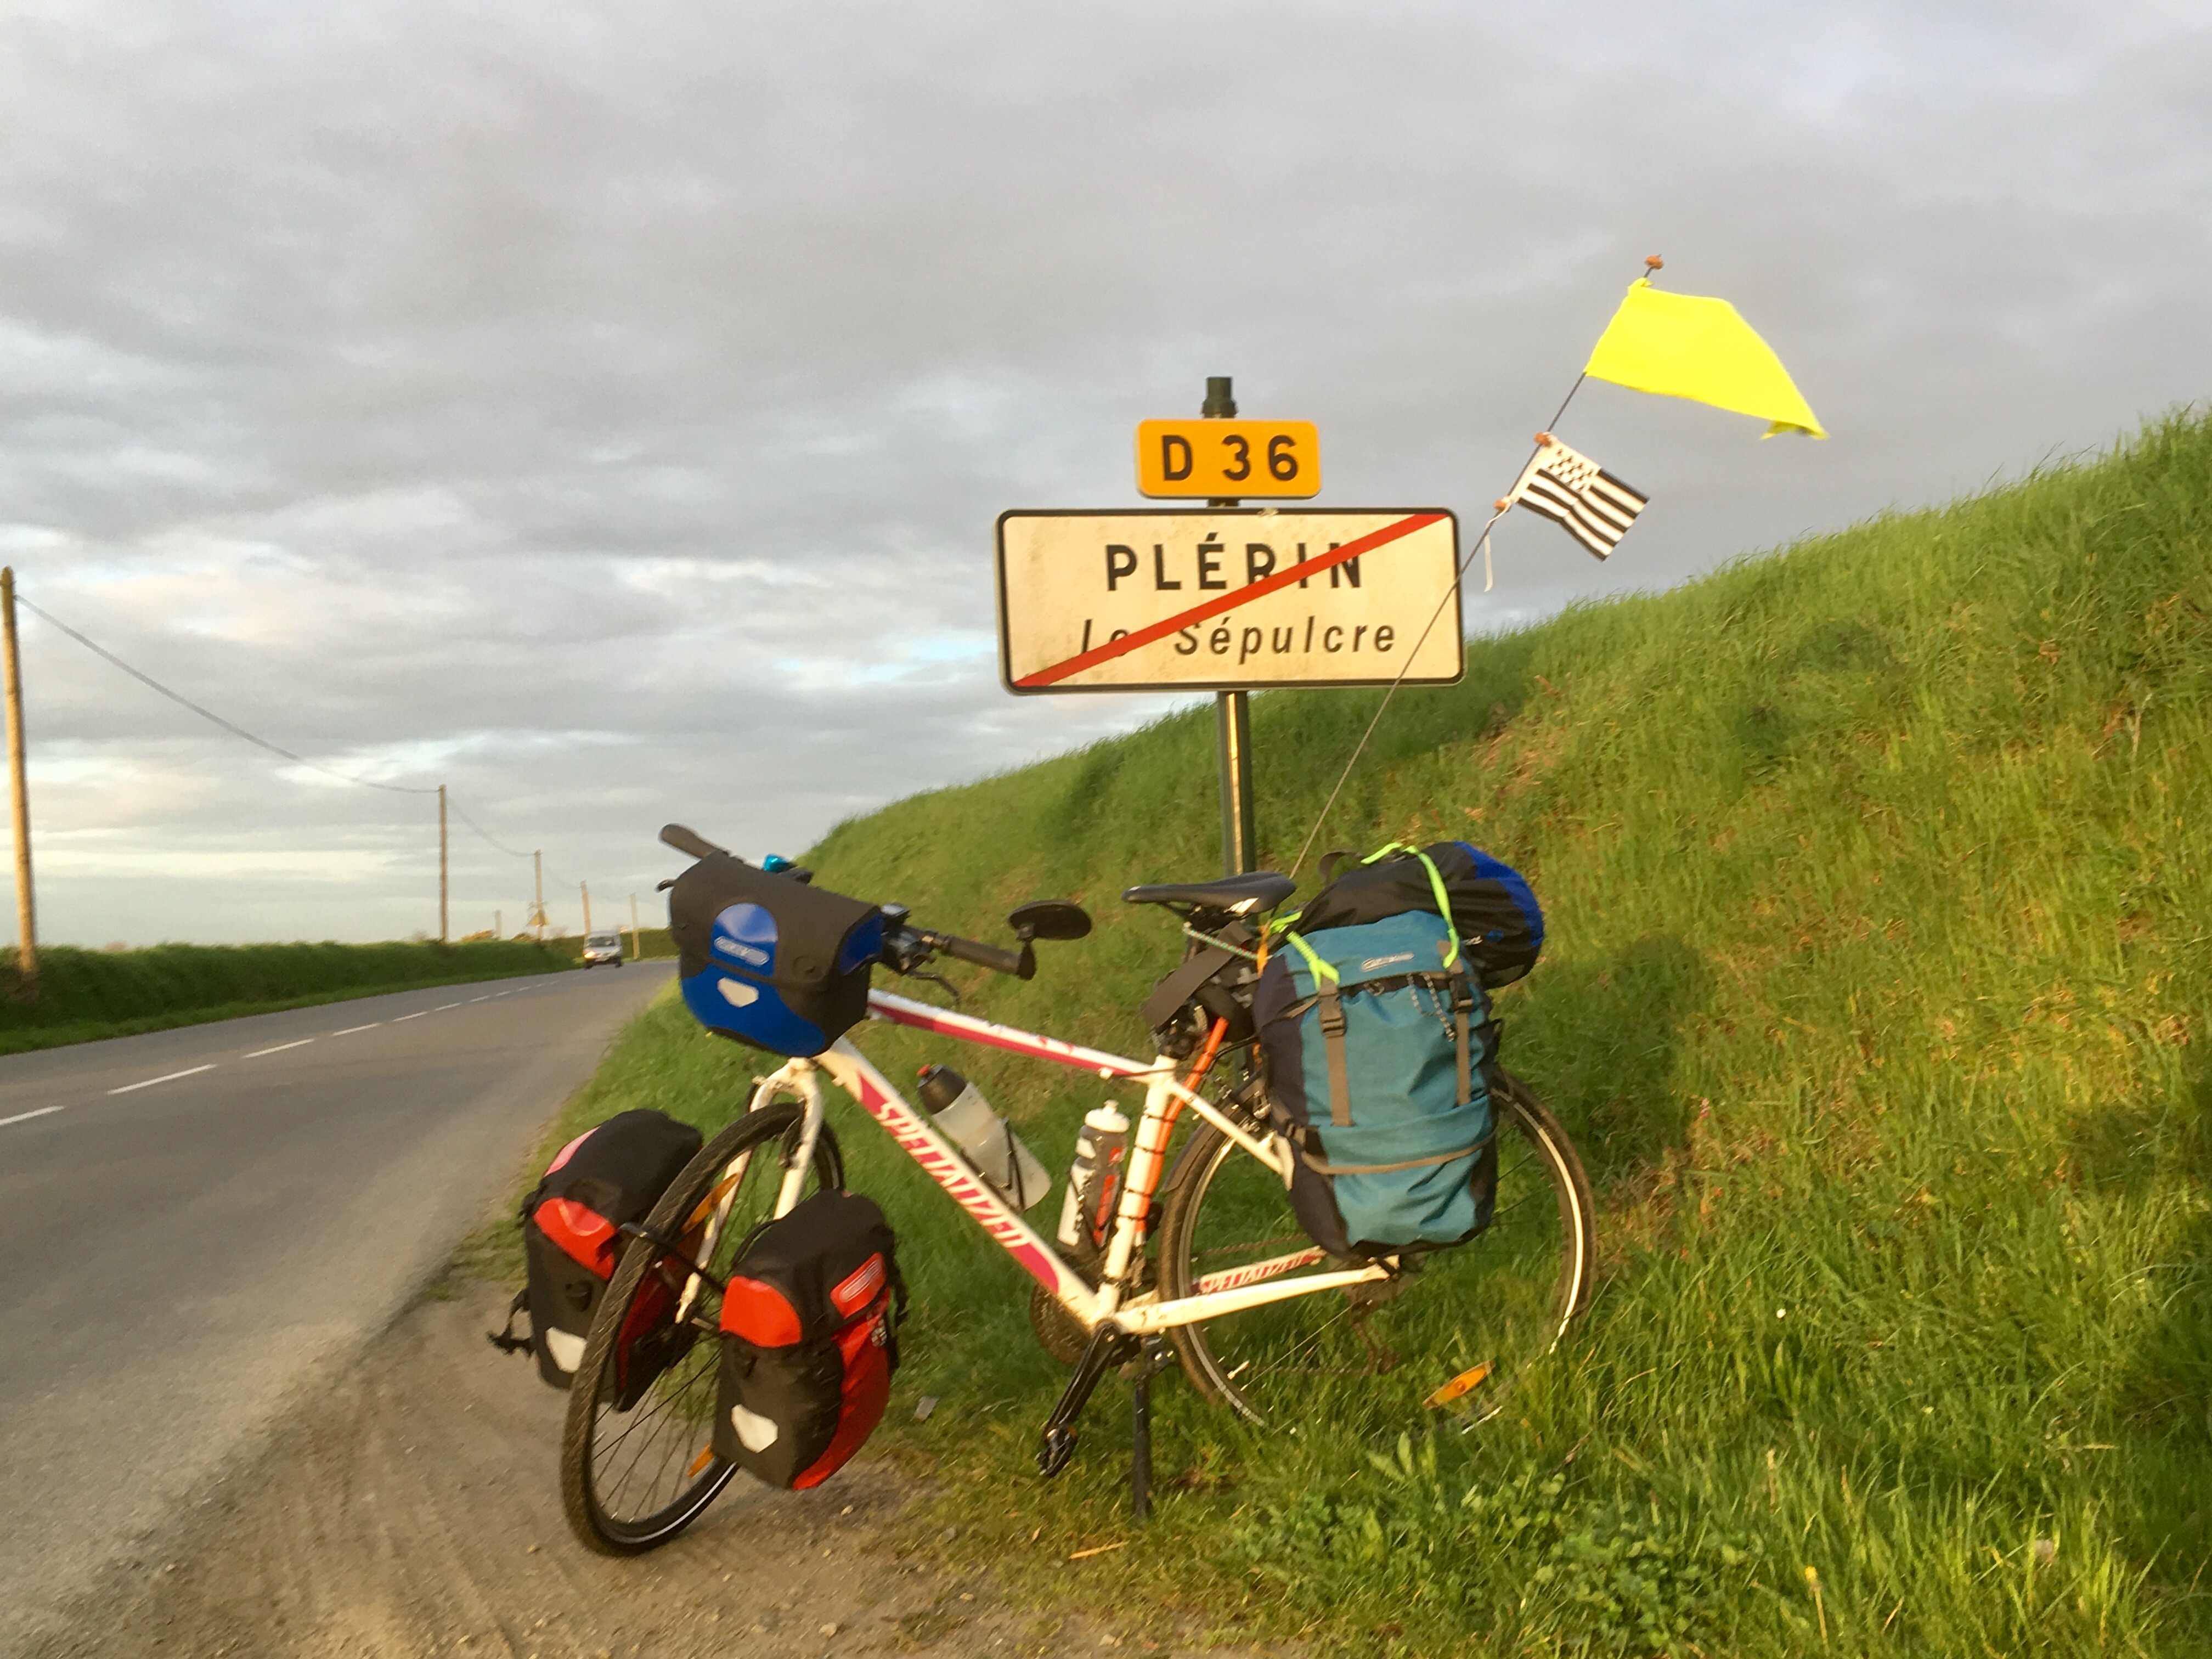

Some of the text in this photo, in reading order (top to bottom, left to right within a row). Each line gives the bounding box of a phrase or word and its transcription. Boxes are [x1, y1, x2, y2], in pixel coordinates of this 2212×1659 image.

[1162, 434, 1299, 481] D 36
[1105, 532, 1362, 591] PLÉRIN
[1174, 616, 1397, 665] Sépulcre
